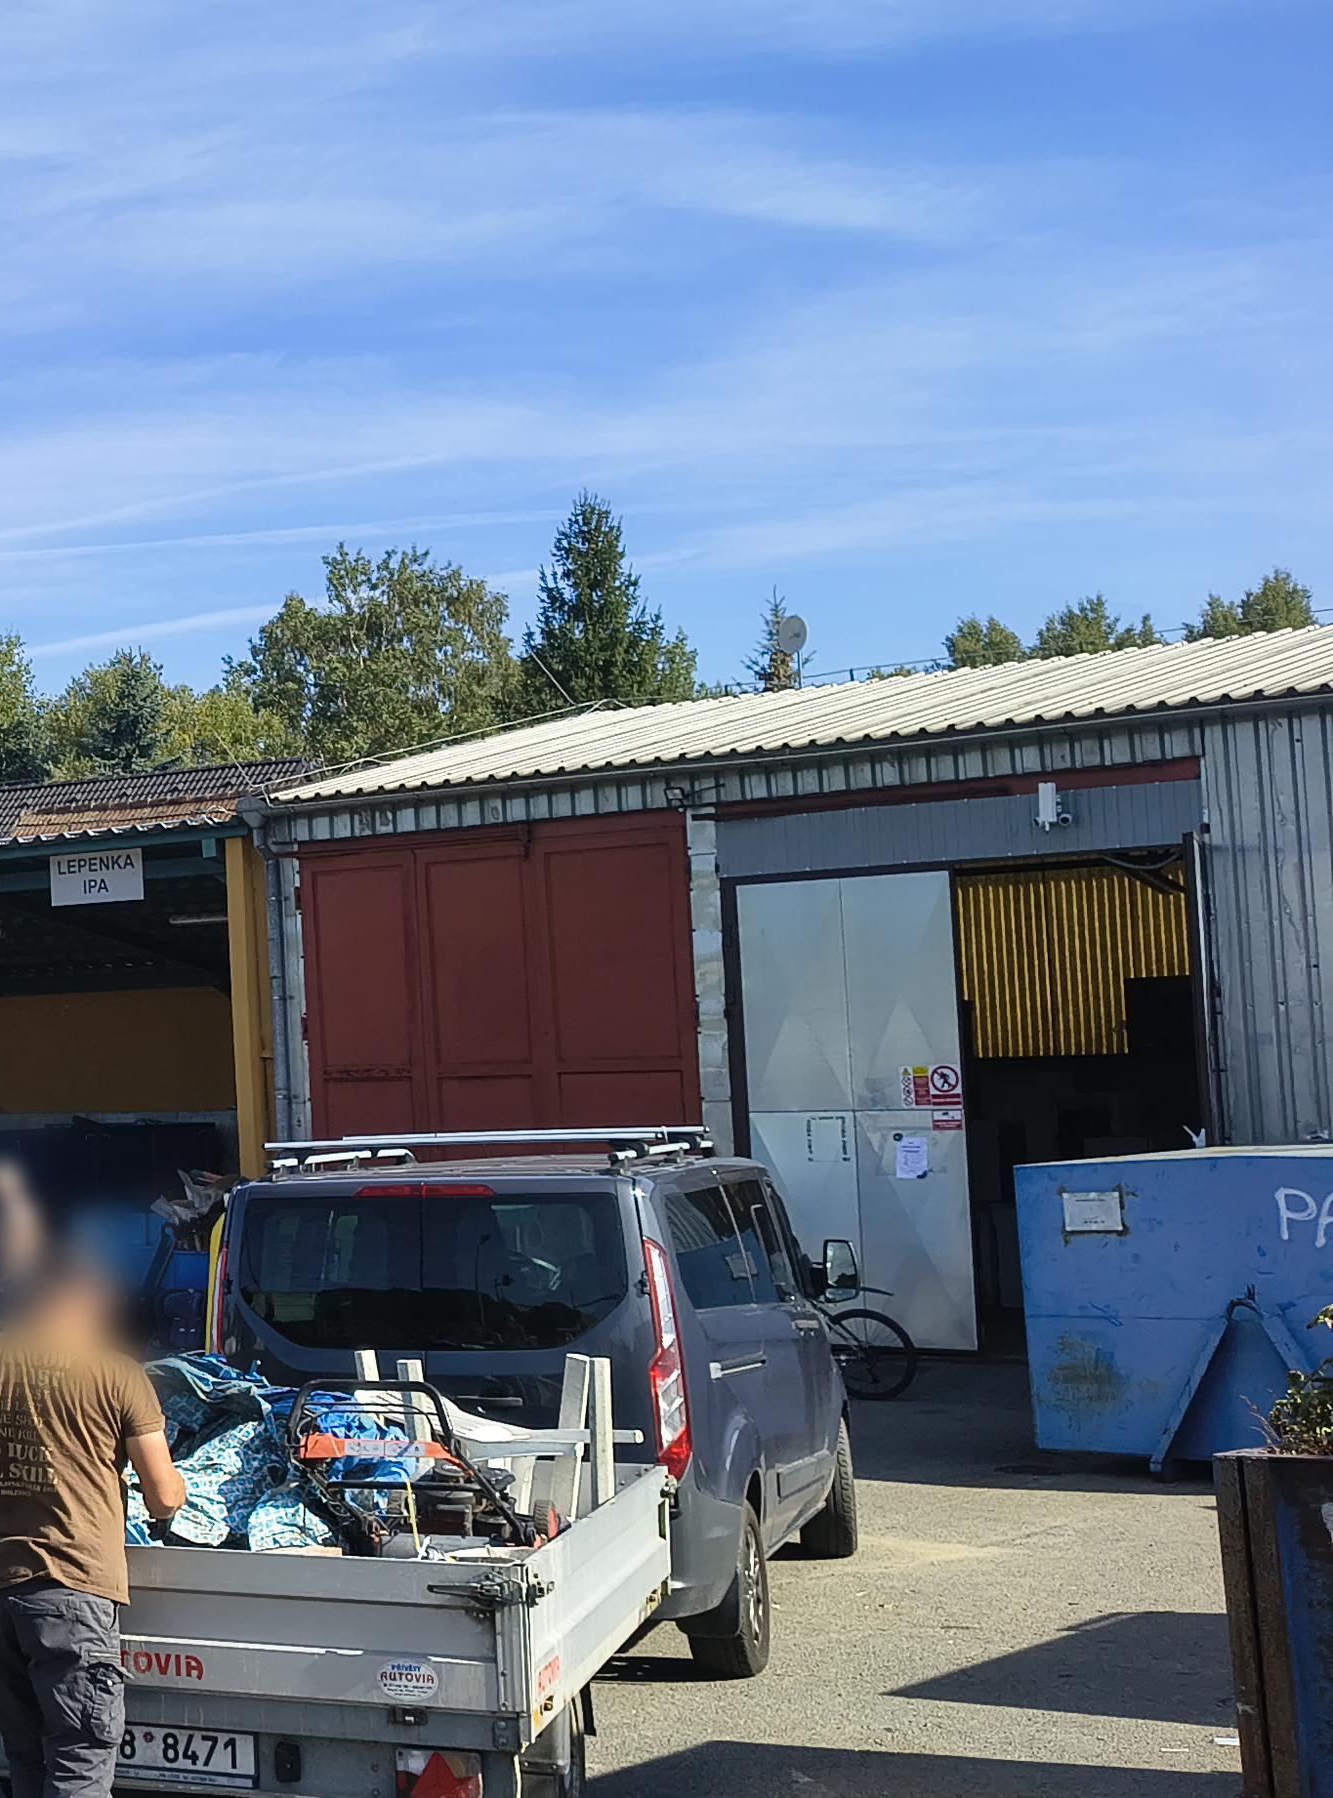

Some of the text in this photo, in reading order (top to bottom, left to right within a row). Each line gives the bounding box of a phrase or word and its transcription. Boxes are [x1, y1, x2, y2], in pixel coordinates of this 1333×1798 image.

[57, 854, 135, 875] LEPENKA
[83, 878, 109, 894] IPA
[121, 1650, 204, 1680] TOVIA
[380, 1671, 435, 1685] AUTOVIA
[162, 1732, 238, 1770] 8471
